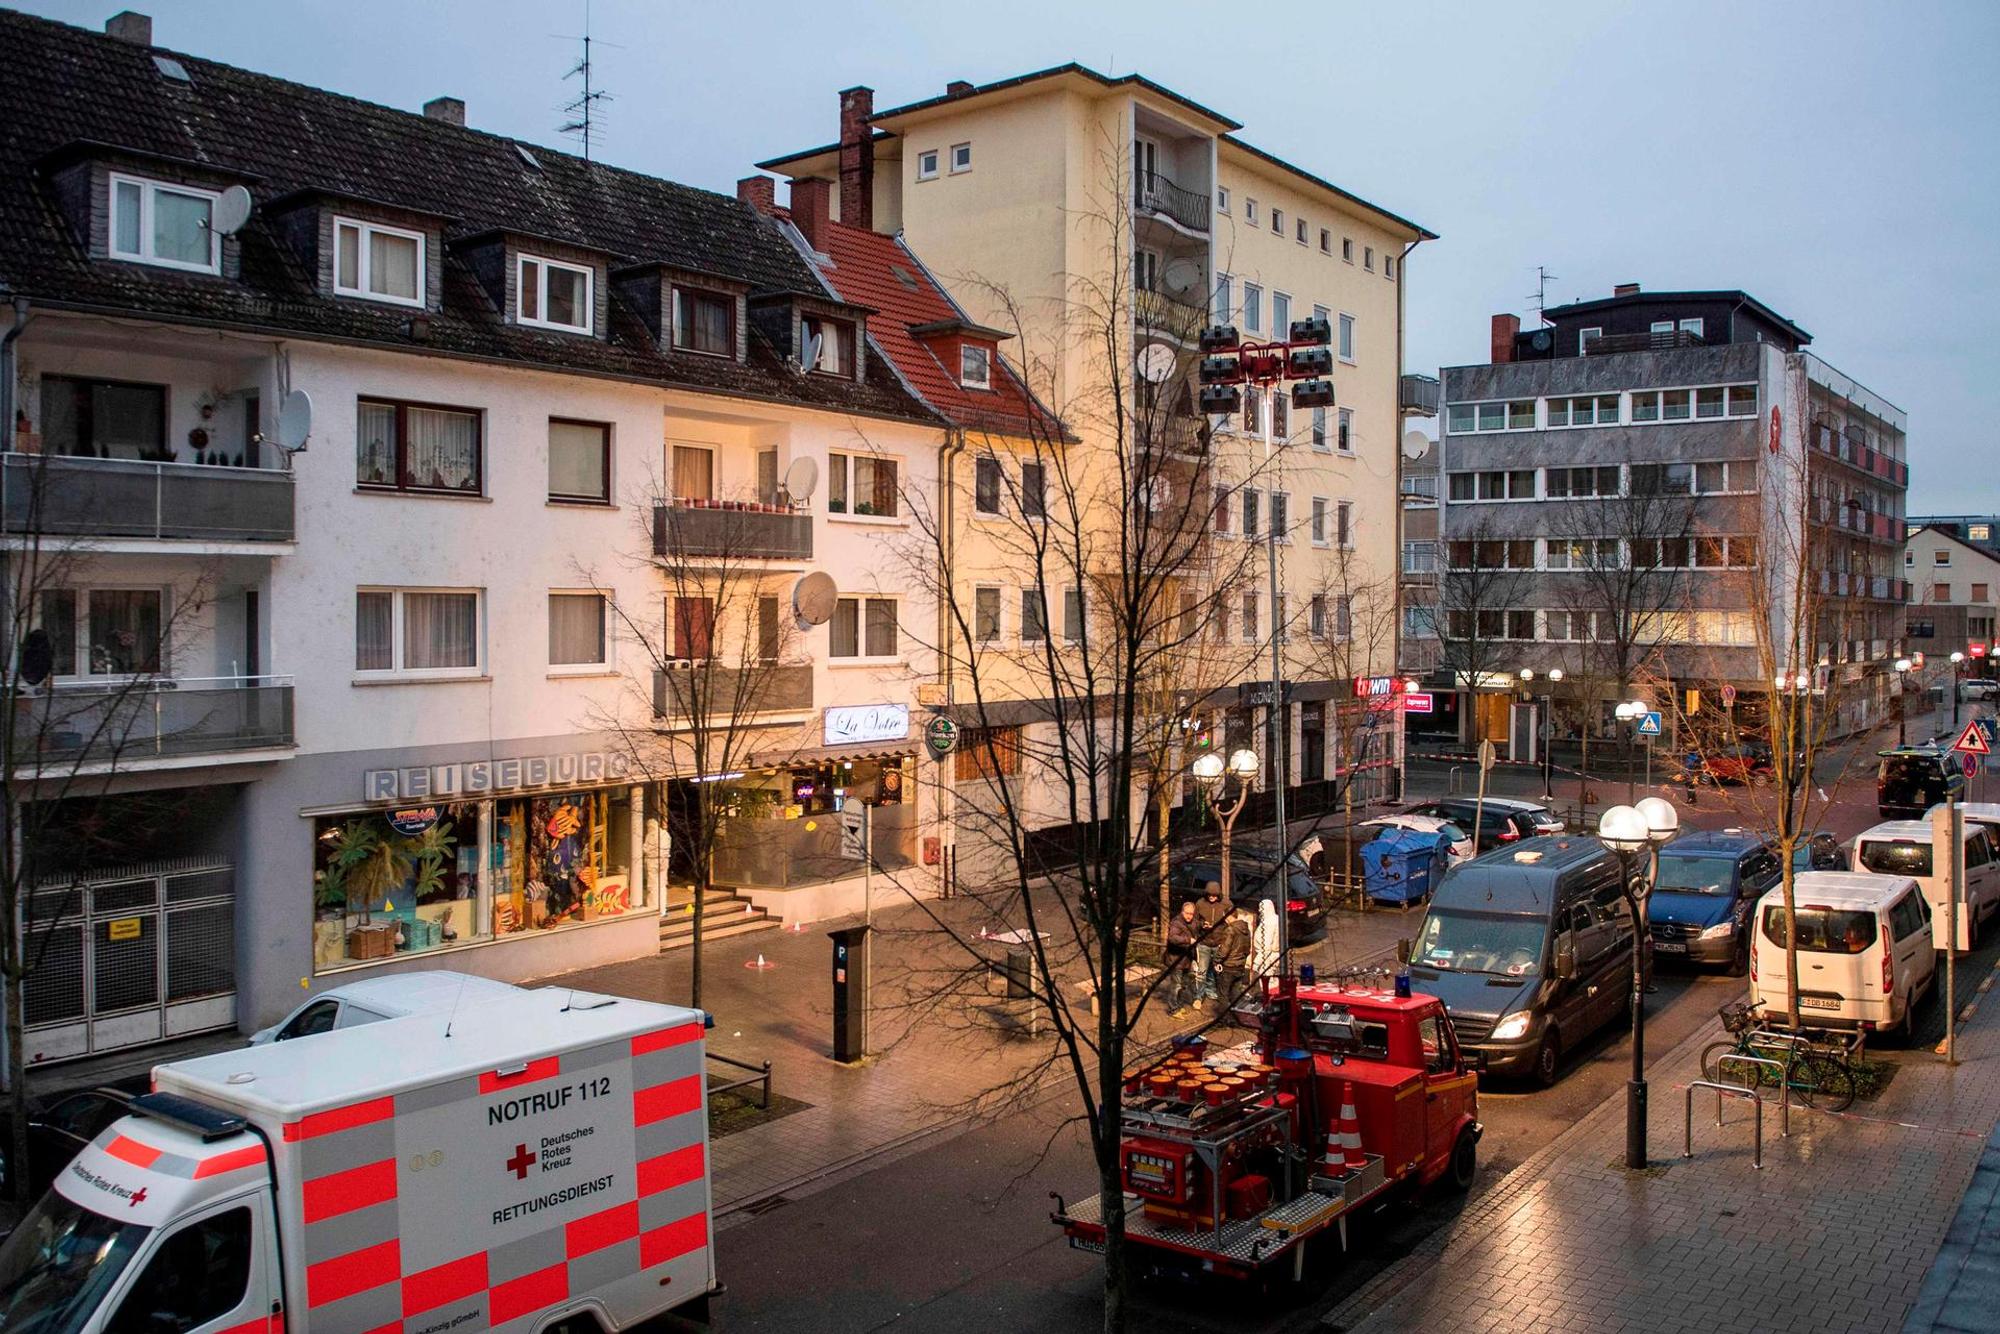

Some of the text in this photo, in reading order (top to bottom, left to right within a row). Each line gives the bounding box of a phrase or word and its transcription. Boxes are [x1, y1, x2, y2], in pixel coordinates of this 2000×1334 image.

[836, 711, 858, 736] La
[374, 752, 630, 800] REISEBURG
[488, 1077, 611, 1126] NOTRUF 112
[541, 1126, 594, 1149] Deutsches
[541, 1145, 571, 1161] Rotes
[541, 1156, 572, 1173] Kreuz
[109, 1183, 133, 1199] Kreuz
[492, 1174, 614, 1225] RETTUNGSDIENST
[451, 1309, 480, 1328] gGmbH
